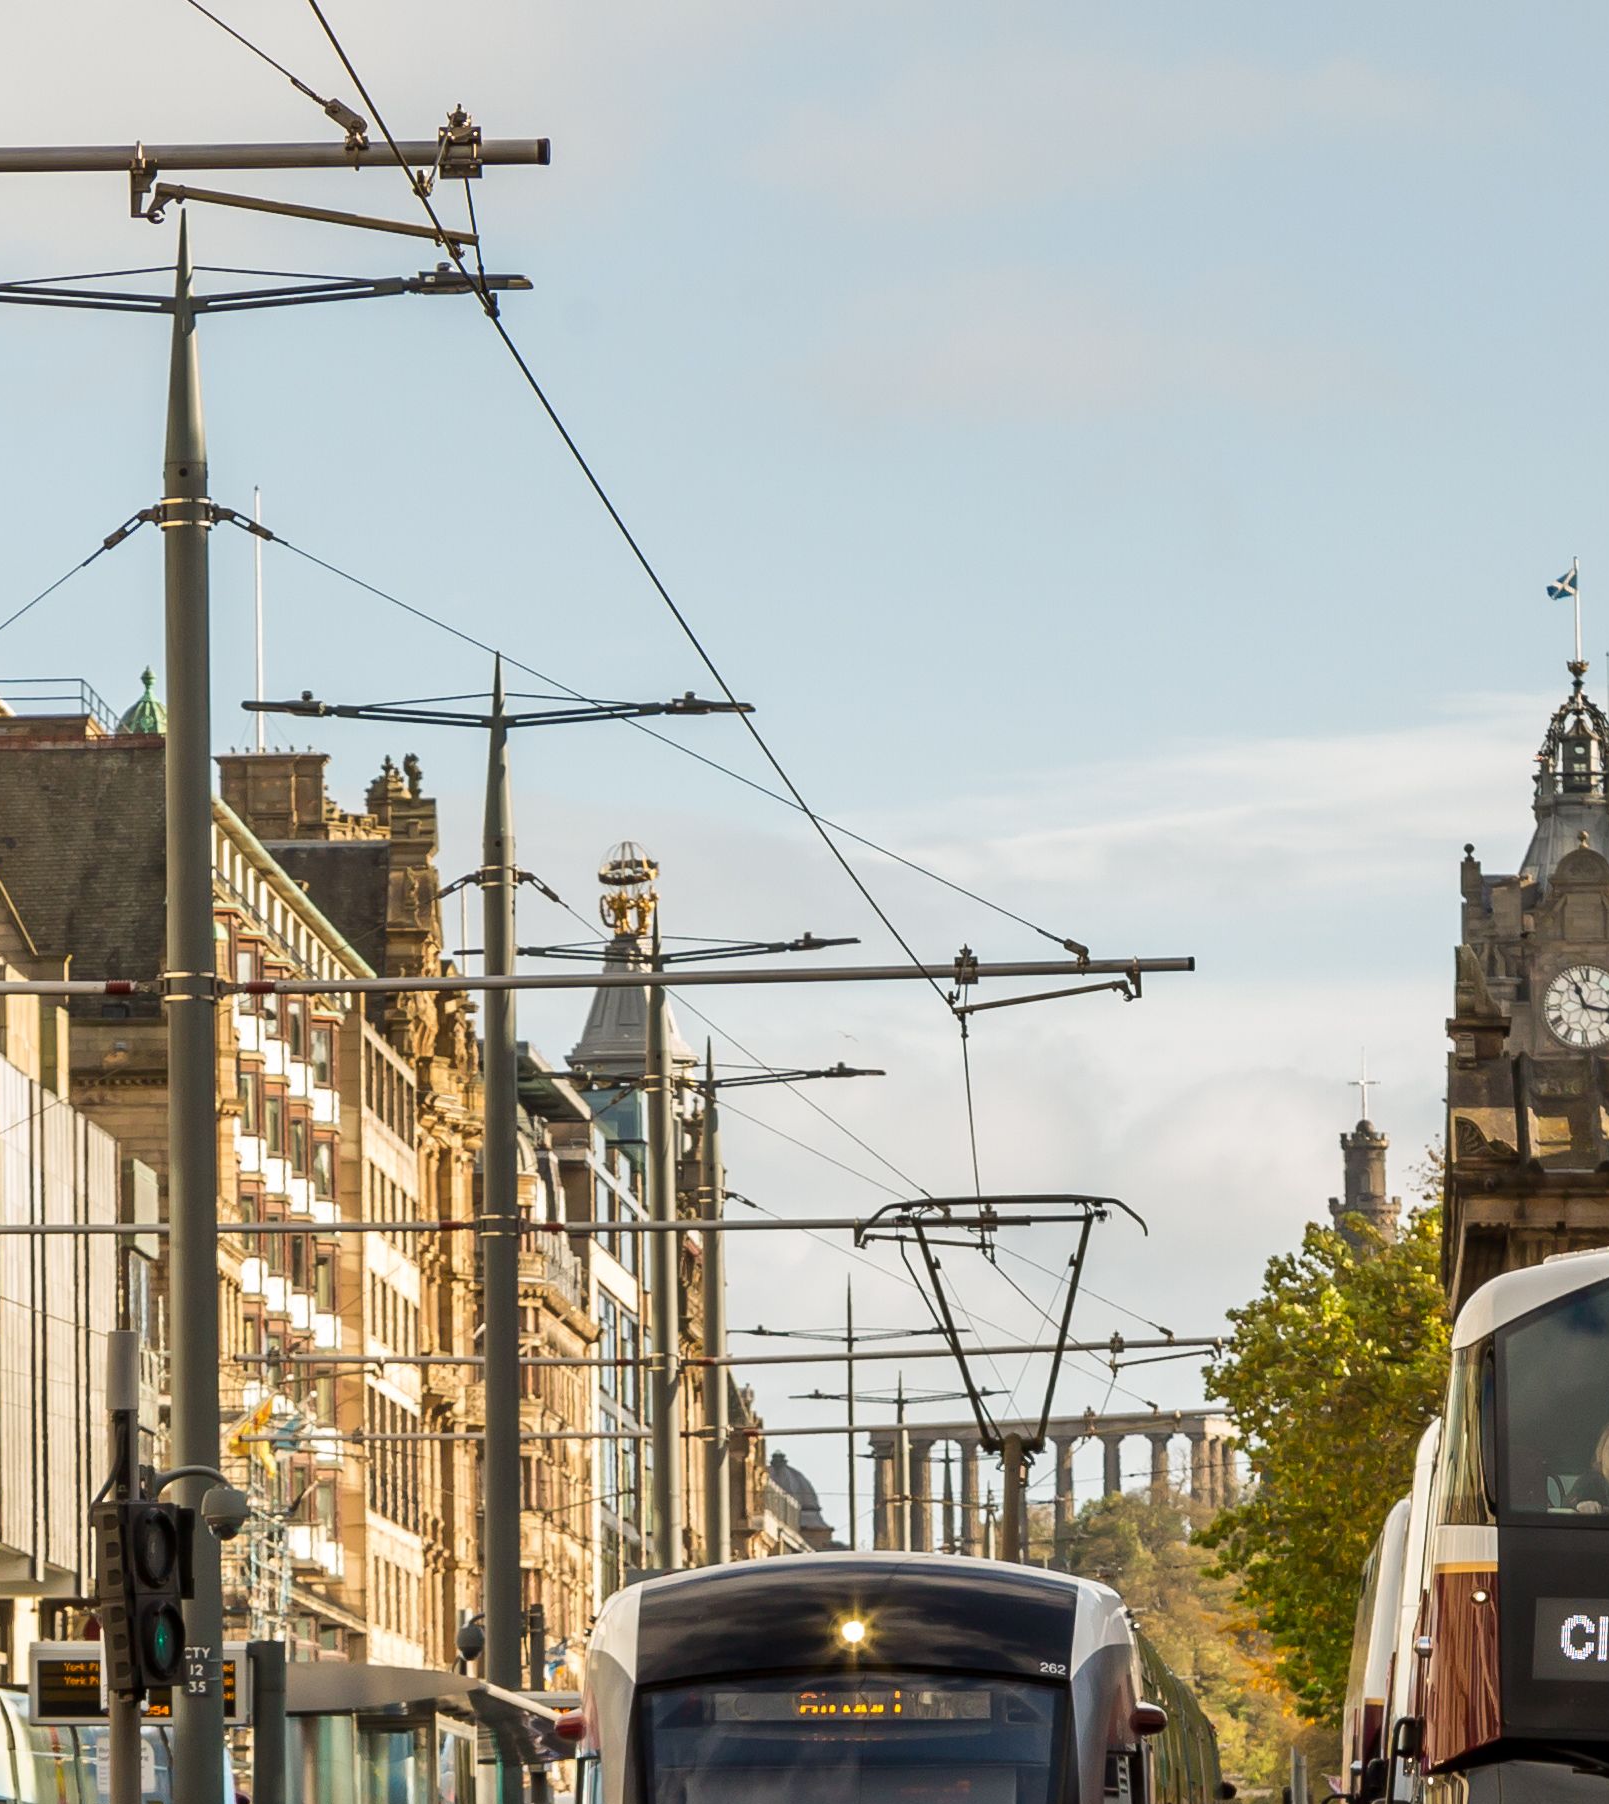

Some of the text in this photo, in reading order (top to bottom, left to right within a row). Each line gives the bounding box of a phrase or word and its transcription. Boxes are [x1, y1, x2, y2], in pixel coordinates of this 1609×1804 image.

[189, 1663, 204, 1677] 12
[1039, 1661, 1066, 1676] 262
[188, 1681, 207, 1693] 35
